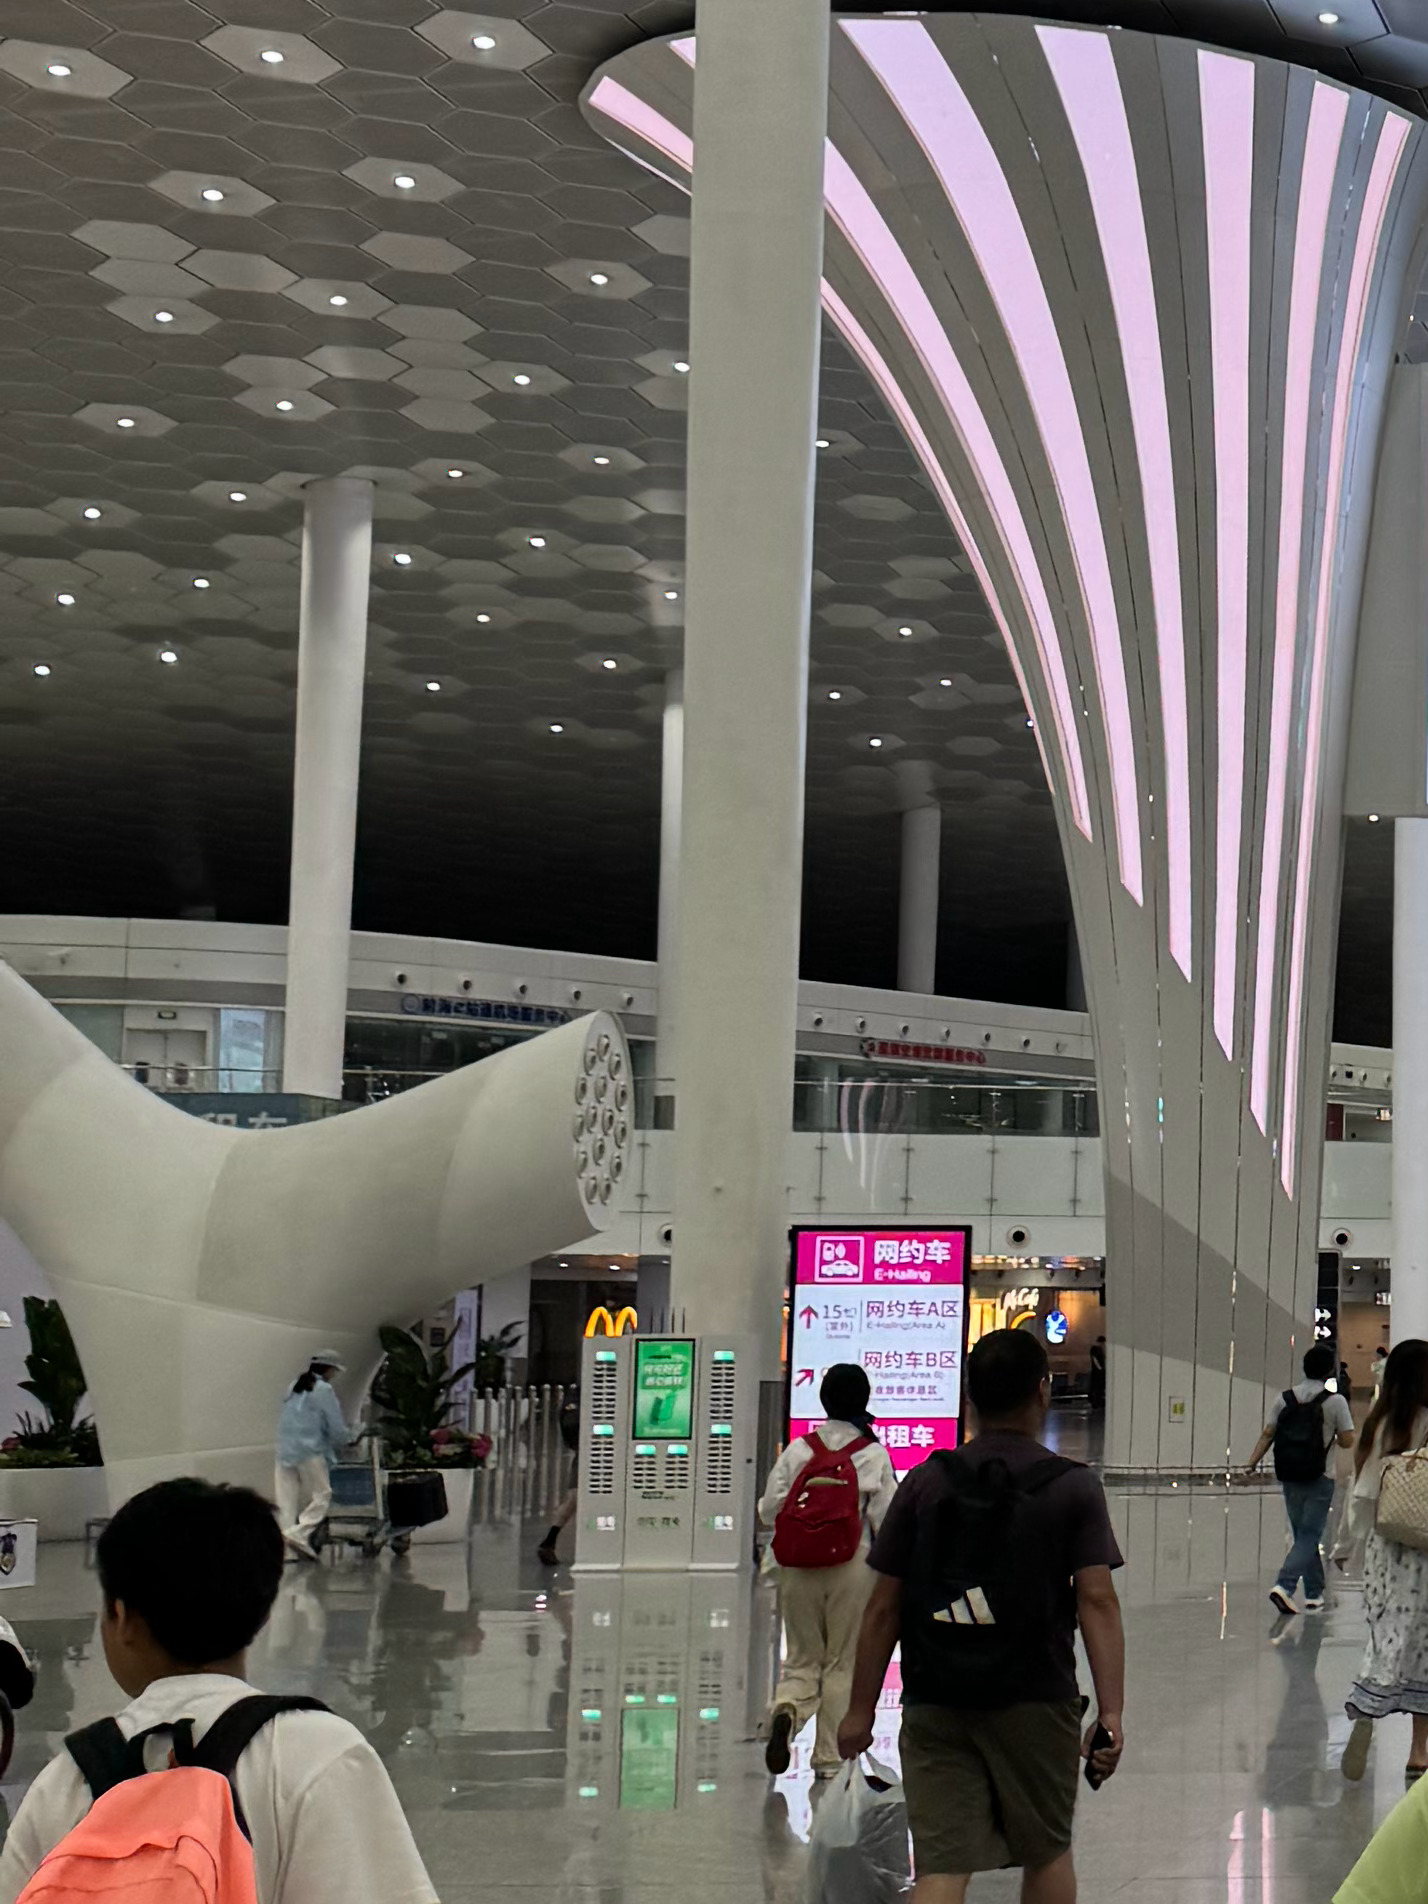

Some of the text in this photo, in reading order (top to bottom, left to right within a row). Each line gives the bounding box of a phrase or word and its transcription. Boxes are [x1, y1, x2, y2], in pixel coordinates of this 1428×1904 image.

[873, 1239, 952, 1265] 网约车
[873, 1268, 932, 1283] E-Hailing
[866, 1299, 960, 1319] 网约车A区
[864, 1350, 958, 1369] 网约车B区
